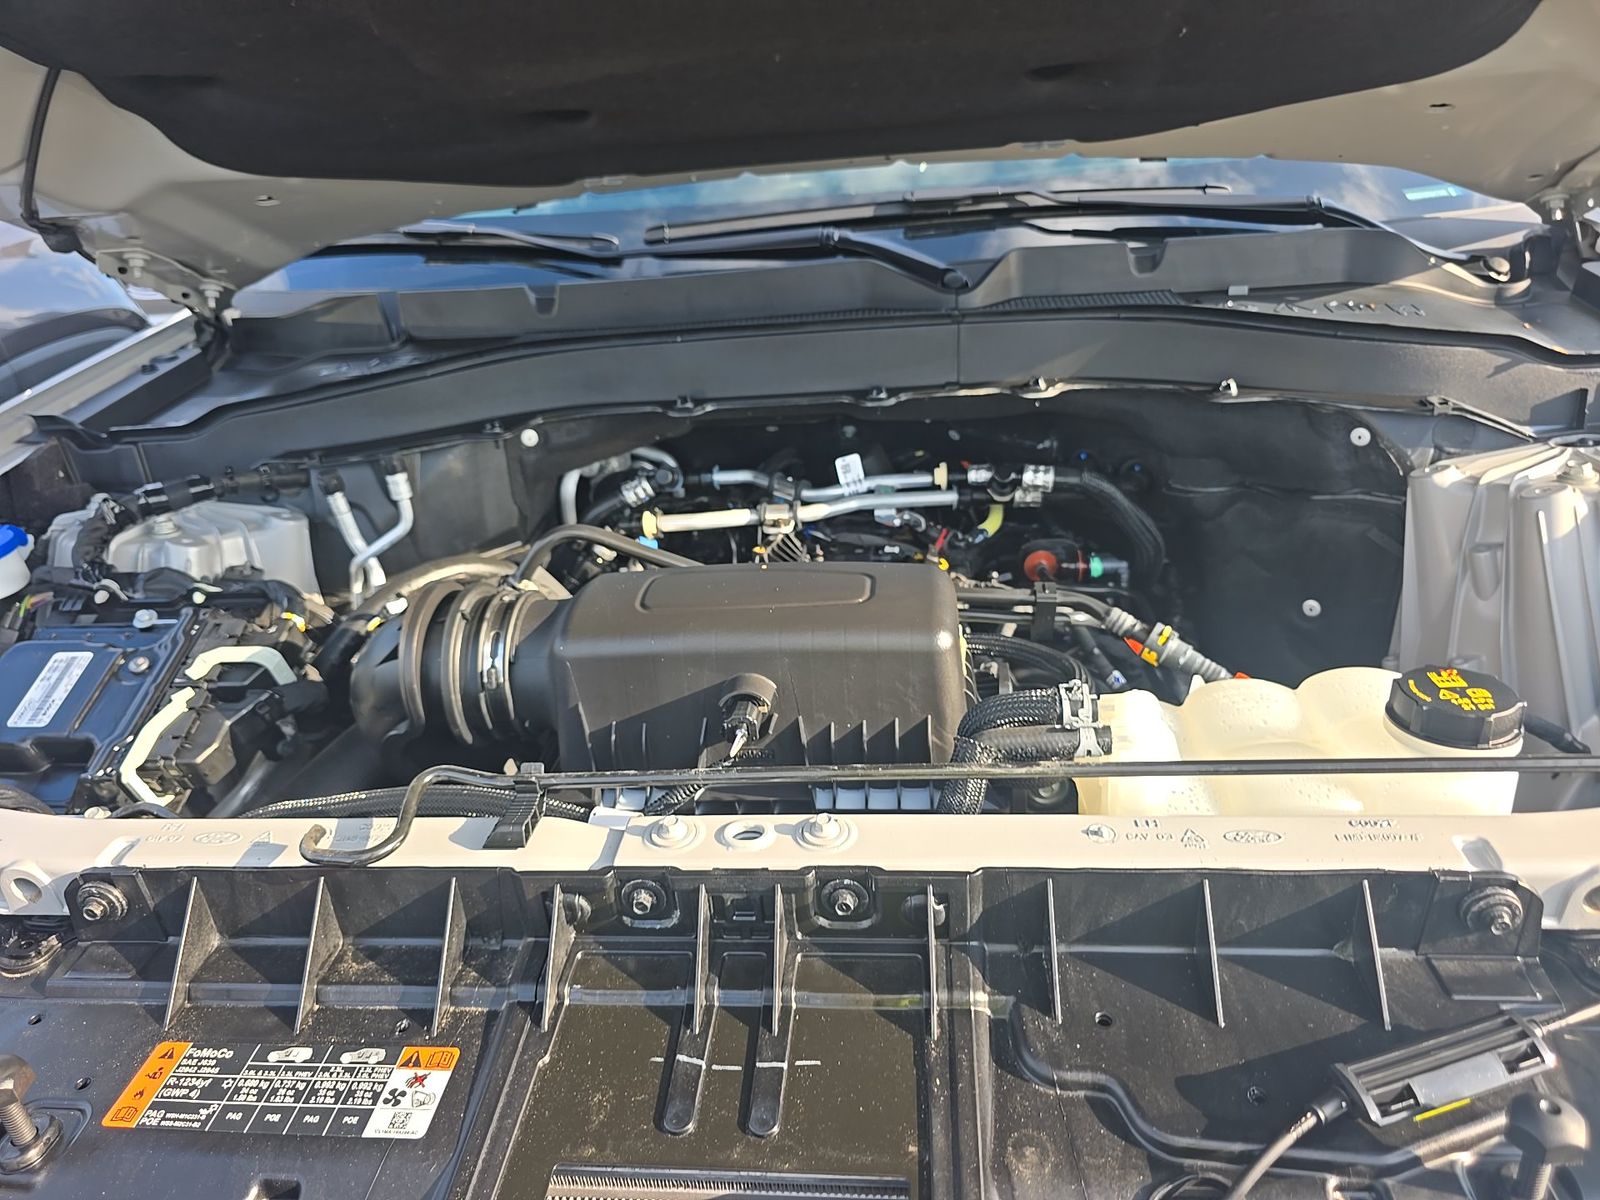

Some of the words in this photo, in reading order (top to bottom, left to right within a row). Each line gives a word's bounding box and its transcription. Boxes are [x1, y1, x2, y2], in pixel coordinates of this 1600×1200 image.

[186, 1047, 234, 1059] FoMoCo
[167, 1077, 213, 1088] R-1234yf
[259, 1080, 270, 1089] kg
[295, 1081, 306, 1090] kg
[336, 1081, 347, 1091] kg
[373, 1082, 384, 1092] kg
[158, 1087, 188, 1098] (GWP
[188, 1088, 201, 1099] 4)
[145, 1110, 165, 1118] PAG
[225, 1112, 243, 1120] PAG
[264, 1113, 281, 1122] POE
[139, 1117, 161, 1126] POE
[303, 1115, 320, 1123] PAG
[342, 1116, 359, 1124] POE
